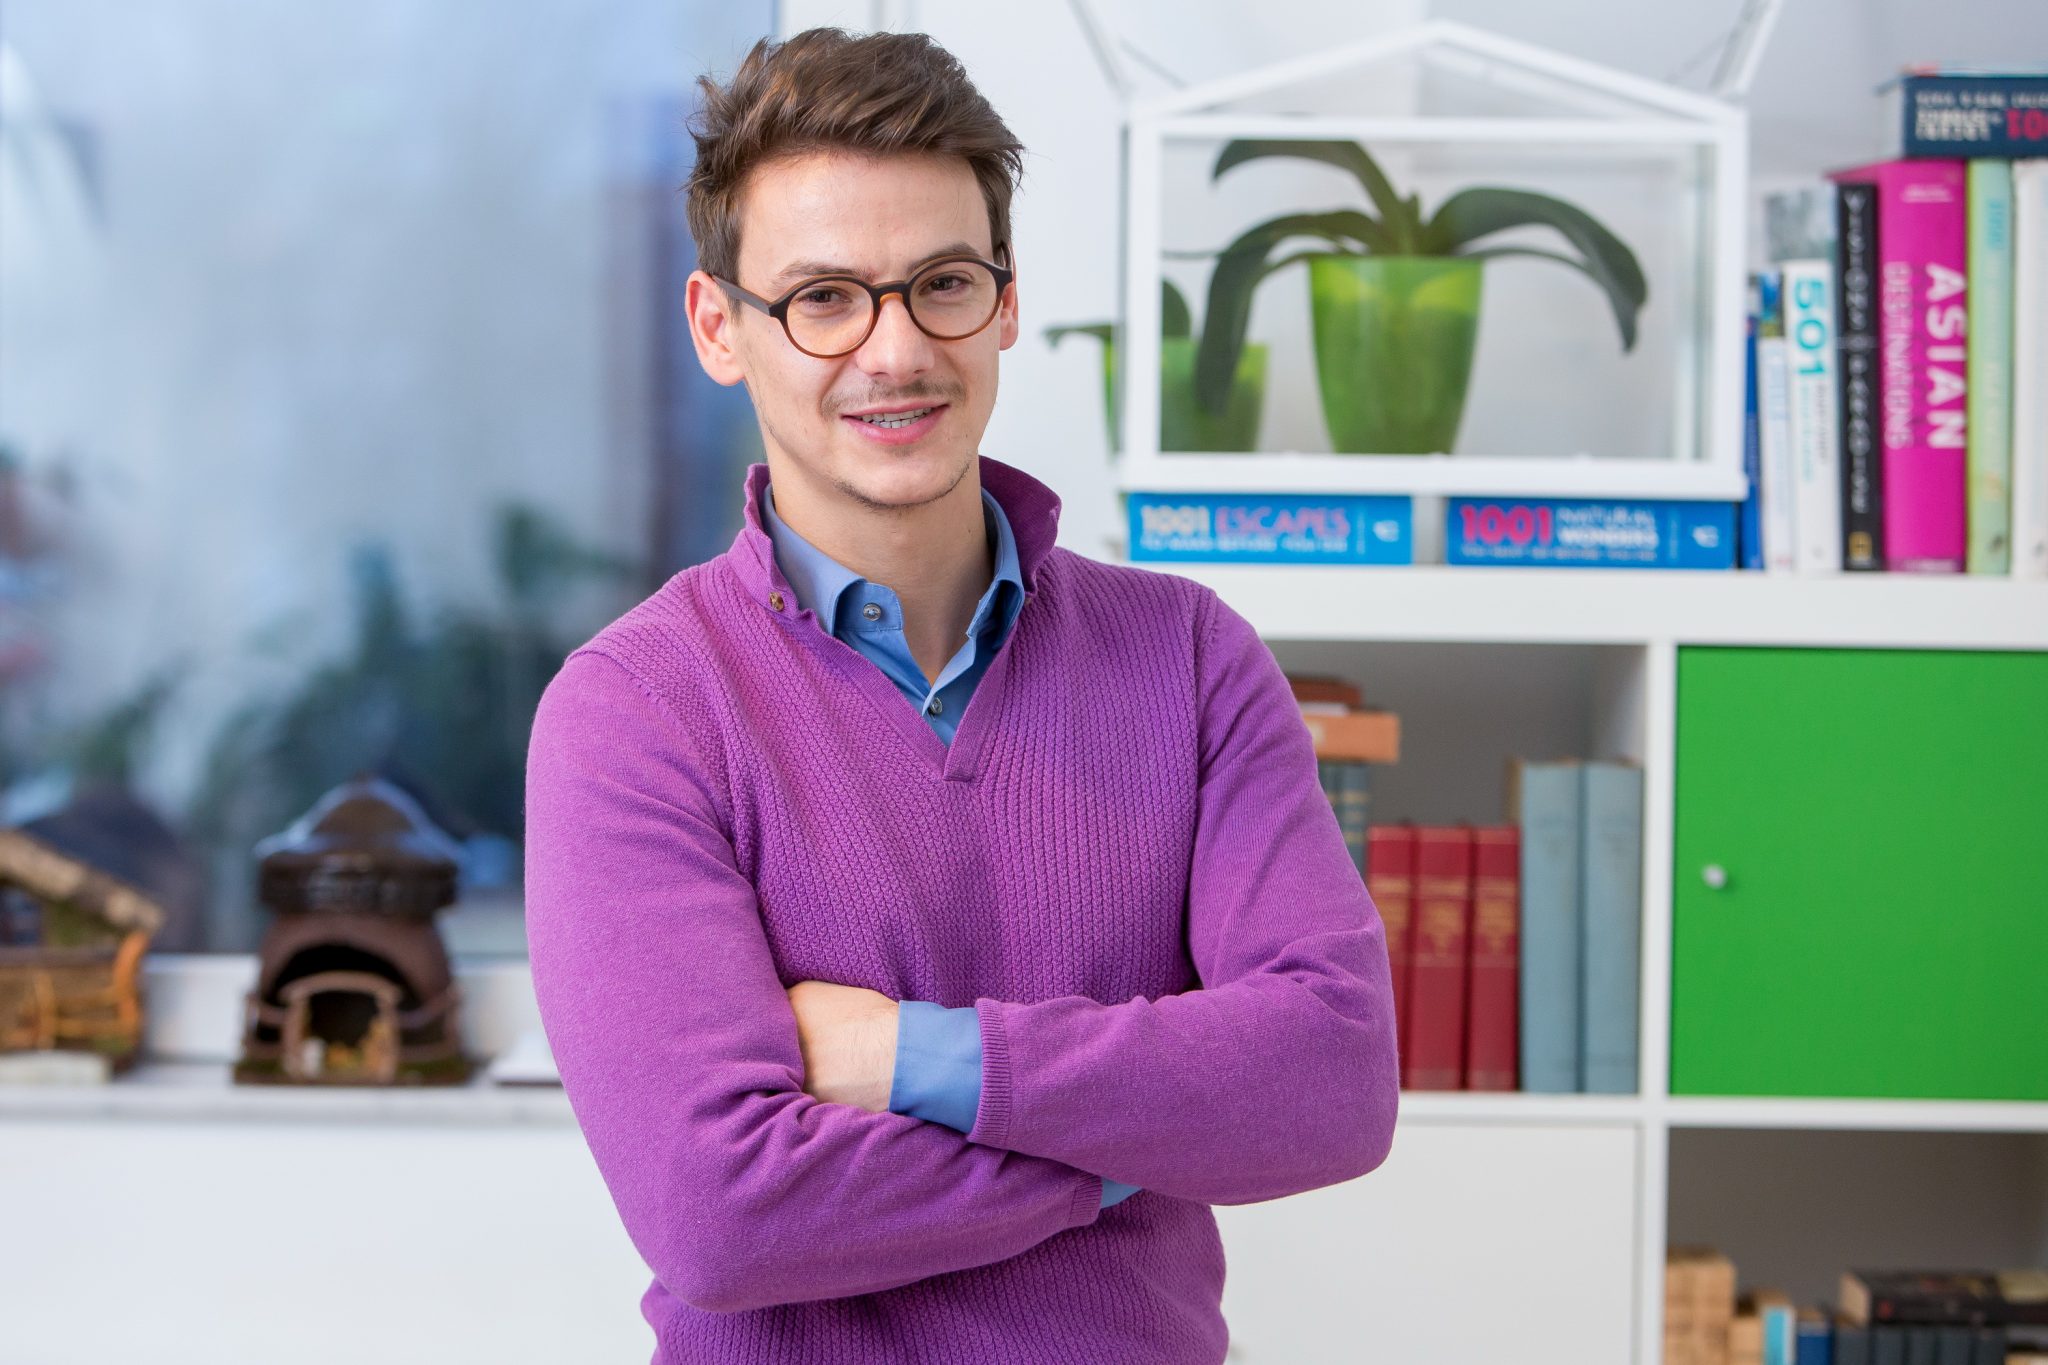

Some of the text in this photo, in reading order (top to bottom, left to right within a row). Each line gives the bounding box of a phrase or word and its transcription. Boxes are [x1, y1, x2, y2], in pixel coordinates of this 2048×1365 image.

[1795, 279, 1826, 376] 501
[1883, 261, 1912, 450] DESTINATIONS
[1926, 262, 1966, 448] ASIAN
[1141, 505, 1210, 534] 1001
[1215, 506, 1350, 537] ESCAPES
[1461, 505, 1553, 545] 1001
